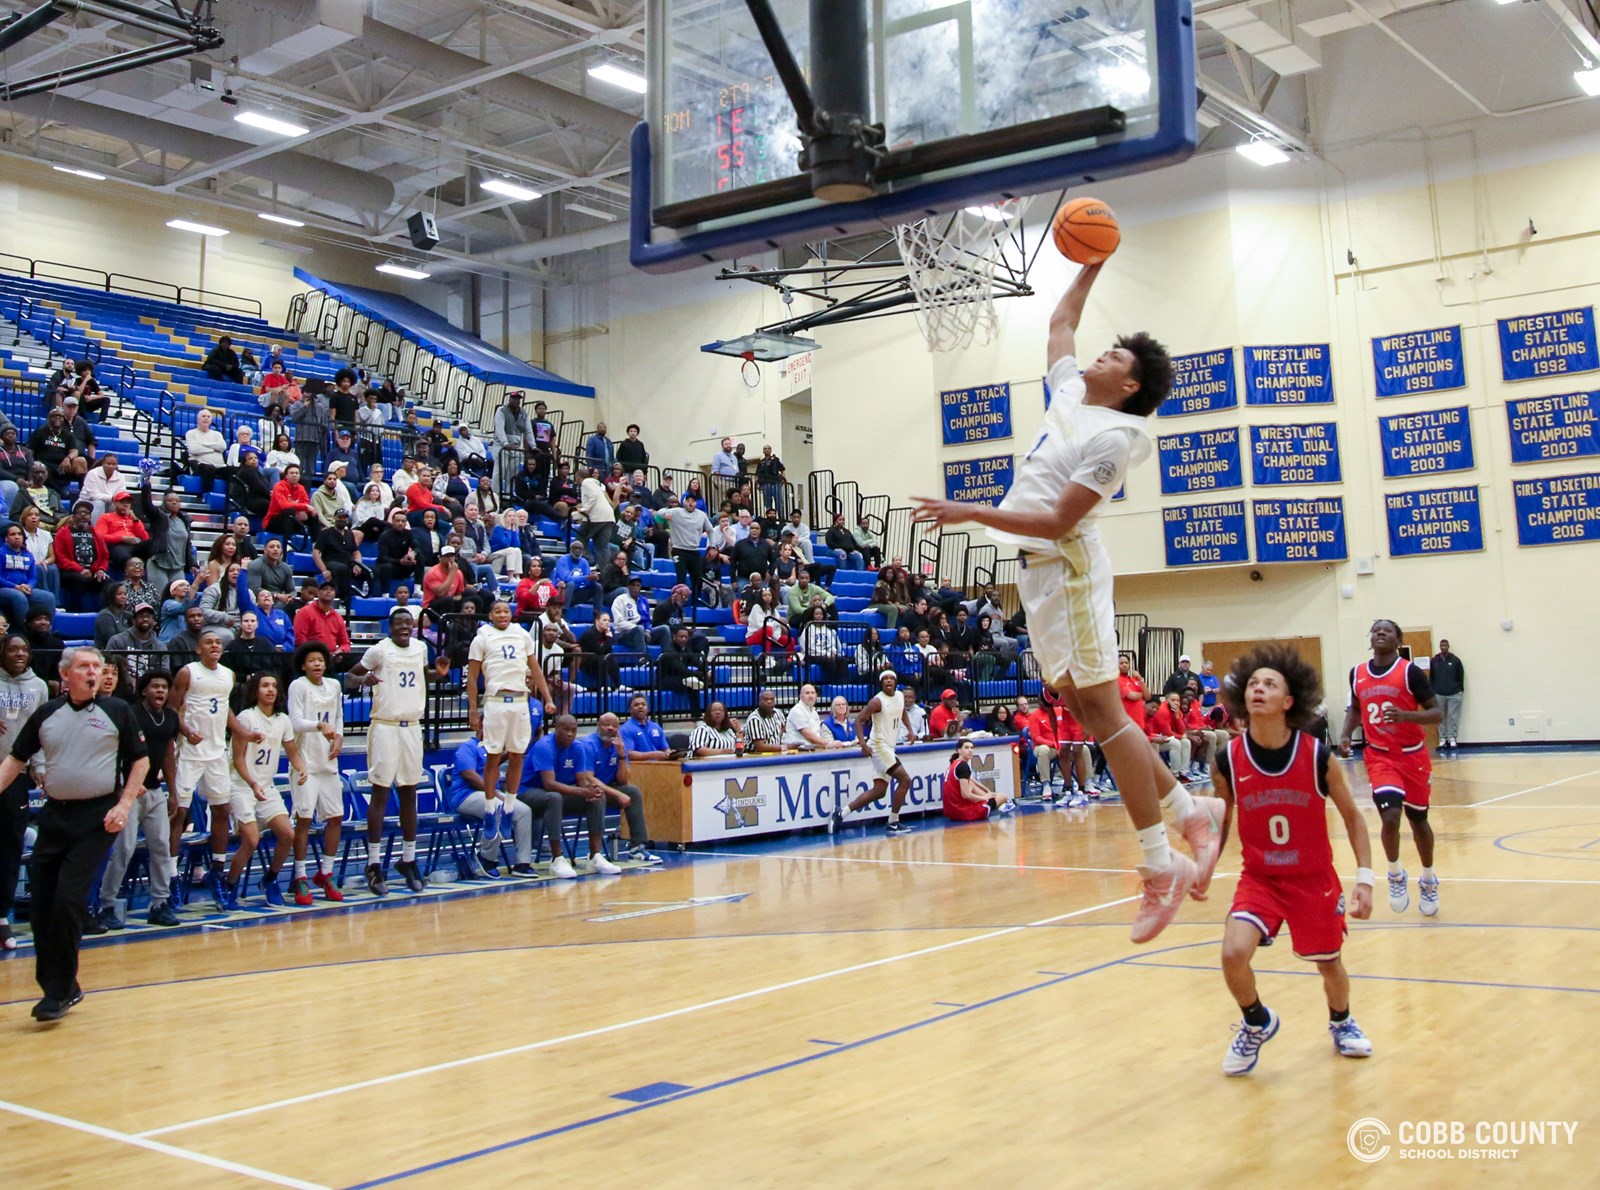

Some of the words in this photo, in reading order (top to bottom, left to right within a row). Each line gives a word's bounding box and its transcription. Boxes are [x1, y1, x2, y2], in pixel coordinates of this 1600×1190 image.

[1507, 311, 1584, 334] WRESTLING
[1381, 330, 1452, 351] WRESTLING
[1524, 328, 1569, 346] STATE
[1253, 348, 1322, 361] WRESTLING
[1397, 346, 1437, 363] STATE
[1512, 341, 1586, 362] CHAMPIONS
[1170, 353, 1225, 371] RESTLING
[1268, 362, 1307, 375] STATE
[1384, 359, 1454, 379] CHAMPIONS
[1534, 359, 1567, 375] 1992
[1176, 369, 1212, 385] STATE
[1256, 376, 1323, 389] CHAMPIONS
[1406, 376, 1434, 390] 1991
[943, 392, 969, 405] BOYS
[975, 386, 1006, 400] TRACK
[1167, 381, 1226, 399] HAMPIONS
[1276, 390, 1305, 402] 1990
[960, 401, 990, 416] STATE
[1183, 397, 1210, 412] 1989
[1516, 394, 1589, 415] WRESTLING
[950, 412, 1003, 429] CHAMPIONS
[1388, 410, 1460, 432] WRESTLING
[1512, 413, 1554, 431] STATE
[1564, 409, 1598, 424] DUAL
[965, 427, 989, 441] 1963
[1160, 437, 1191, 450] GIRLS
[1201, 431, 1236, 445] TRACK
[1259, 426, 1325, 440] WRESTLING
[1404, 427, 1445, 444] STATE
[1521, 424, 1592, 445] CHAMPIONS
[1181, 447, 1217, 462] STATE
[1256, 441, 1293, 454] STATE
[1303, 441, 1333, 452] DUAL
[1391, 440, 1462, 459] CHAMPIONS
[1541, 441, 1578, 457] 2003
[946, 463, 971, 476] BOYS
[979, 458, 1009, 472] TRACK
[1169, 460, 1229, 477] CHAMPIONS
[1263, 455, 1327, 468] CHAMPIONS
[1410, 457, 1445, 472] 2003
[964, 473, 995, 487] STATE
[1187, 476, 1216, 490] 1999
[1281, 469, 1314, 481] 2002
[953, 485, 1004, 501] CHAMPIONS
[1516, 482, 1543, 497] GIRLS
[1550, 476, 1600, 493] BASKETBA
[1387, 494, 1413, 510] GIRLS
[1419, 490, 1476, 507] BASKETBALL
[1542, 493, 1587, 509] STATE
[1164, 508, 1187, 521] GIRLS
[1193, 504, 1243, 519] BASKETBALL
[1255, 503, 1281, 516] GIRLS
[1286, 502, 1341, 515] BASKETBALL
[1412, 506, 1454, 521] STATE
[1186, 519, 1223, 533] STATE
[1279, 517, 1319, 530] STATE
[1399, 520, 1470, 538] CHAMPIONS
[1552, 524, 1585, 539] 2016
[1174, 533, 1237, 549] CHAMPIONS
[1266, 531, 1334, 544] CHAMPIONS
[1421, 536, 1451, 550] 2015
[1192, 548, 1221, 561] 2012
[1286, 546, 1318, 558] 2014
[501, 645, 517, 660] 12
[399, 671, 416, 688] 32
[209, 698, 218, 714] 3
[255, 749, 271, 765] 21
[737, 797, 765, 807] INDIANS
[1269, 815, 1290, 845] 0
